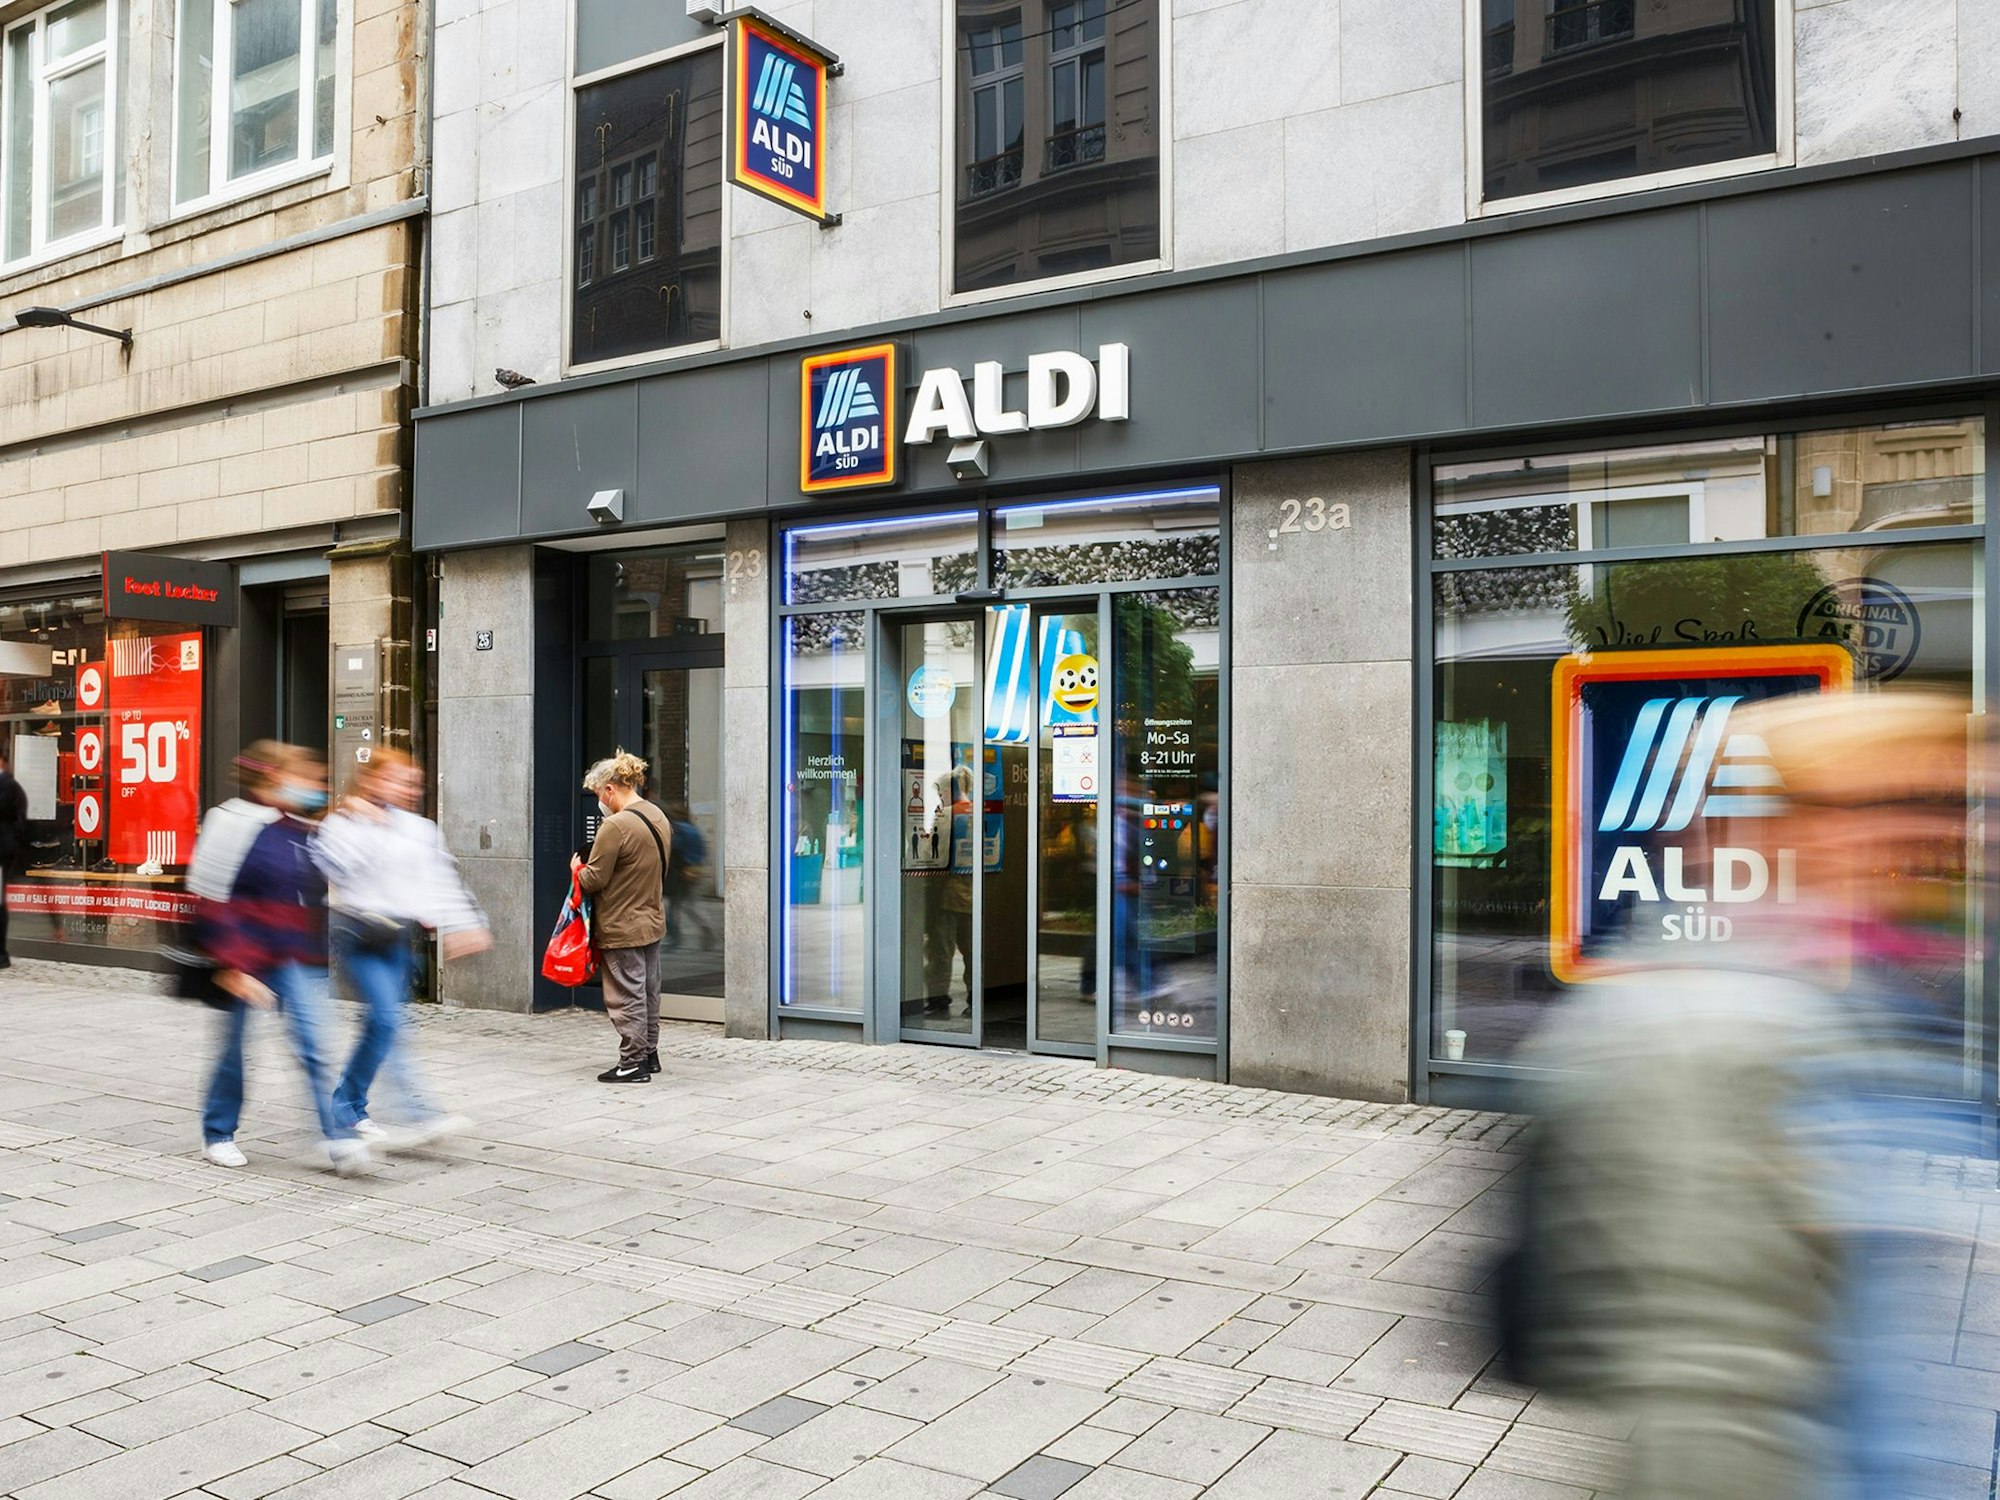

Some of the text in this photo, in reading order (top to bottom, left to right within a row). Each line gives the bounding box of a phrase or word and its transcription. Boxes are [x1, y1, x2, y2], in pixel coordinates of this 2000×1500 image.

[752, 117, 811, 169] ALDI
[771, 156, 793, 178] SÜD
[904, 342, 1129, 444] ALDI
[815, 425, 879, 457] ALDI
[835, 454, 859, 470] SÜD
[1279, 497, 1351, 534] 23a
[729, 549, 761, 579] 23
[124, 576, 218, 602] Foot Locker
[1824, 601, 1899, 621] ORIGINAL
[121, 709, 142, 721] UP TO
[121, 720, 190, 784] 50%
[808, 755, 845, 767] Herzlich
[1172, 750, 1196, 765] Uhr
[796, 768, 857, 780] willkommen!
[1598, 846, 1797, 903] ALDI
[32, 894, 48, 904] SALE
[55, 895, 70, 905] FOOT
[71, 895, 95, 906] LOCKER
[103, 897, 119, 907] SALE
[127, 897, 143, 909] FOOT
[145, 899, 170, 912] LOCKER
[179, 903, 196, 914] SALE
[1662, 906, 1733, 942] SÜD
